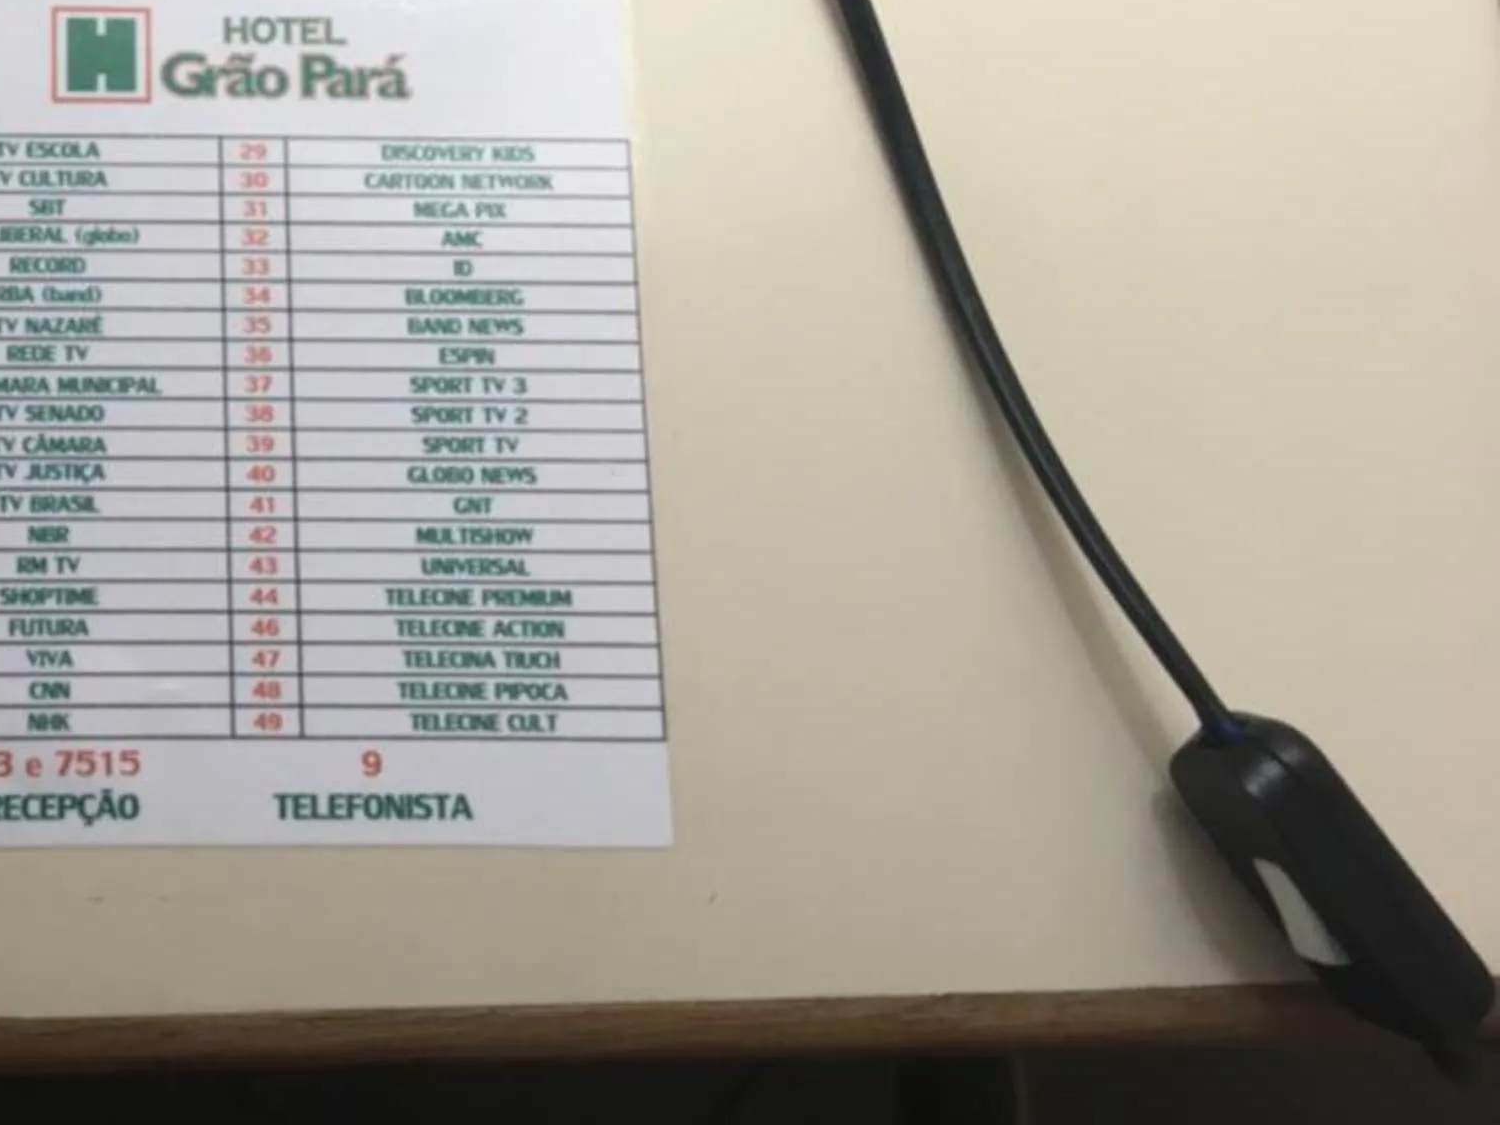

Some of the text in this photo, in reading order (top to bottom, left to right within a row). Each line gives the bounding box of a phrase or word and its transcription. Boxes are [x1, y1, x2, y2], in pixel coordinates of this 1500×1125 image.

[222, 17, 346, 45] HOTEL
[161, 51, 411, 100] Grão Pará
[25, 142, 100, 158] ESCOLA
[239, 145, 267, 159] 29
[381, 145, 534, 162] DISCOVERY KIDS
[19, 171, 108, 186] CULTURA
[240, 174, 268, 188] 30
[365, 174, 553, 190] CARTOON NETWORK
[29, 199, 66, 215] SBT
[243, 203, 267, 216] 31
[413, 202, 507, 219] MEGA PIX
[75, 227, 139, 247] (globo)
[241, 231, 269, 246] 32
[441, 231, 482, 247] AMC
[9, 257, 86, 273] RECORD
[242, 260, 270, 274] 33
[453, 261, 472, 276] ID
[42, 287, 102, 303] (band)
[243, 288, 270, 303] 34
[405, 288, 524, 306] BLOOMBERG
[25, 315, 103, 334] NAZARÉ
[243, 318, 270, 332] 35
[408, 318, 523, 335] BAND NEWS
[6, 346, 89, 362] REDE TV
[244, 347, 271, 363] 36
[57, 378, 161, 394] MUNICIPAL
[244, 377, 273, 392] 37
[410, 378, 527, 394] SPORT TV 3
[24, 406, 105, 421] SENADO
[245, 408, 274, 422] 38
[410, 408, 528, 424] SPORT TV 2
[23, 434, 106, 453] CÂMARA
[246, 437, 274, 452] 39
[422, 437, 520, 454] SPORT TV
[24, 464, 106, 483] JUSTIÇA
[247, 467, 276, 482] 40
[407, 467, 537, 484] GLOBO NEWS
[0, 495, 100, 513] TV BRASIL
[249, 498, 275, 513] 41
[453, 498, 492, 514] GNT
[27, 527, 69, 543] NBR
[249, 528, 276, 543] 42
[416, 528, 533, 545] MULTISHOW
[16, 557, 81, 573] RM TV
[249, 558, 277, 574] 43
[422, 559, 531, 576] UNIVERSAL
[0, 588, 99, 605] SHOPTIME
[249, 589, 278, 604] 44
[386, 589, 572, 606] TELECINE PREMIUM
[8, 620, 88, 636] FUTURA
[250, 620, 280, 636] 46
[396, 620, 565, 638] TELECINE ACTION
[27, 651, 74, 667] VIVA
[252, 651, 280, 667] 47
[29, 682, 70, 699] CNN
[253, 682, 281, 699] 48
[398, 682, 567, 700] TELECINE PIPOCA
[27, 714, 71, 731] NHK
[253, 714, 283, 730] 49
[410, 714, 558, 731] TELECINE CULT
[26, 756, 43, 777] e
[55, 749, 141, 777] 7515
[362, 750, 382, 776] 9
[273, 793, 473, 820] TELEFONISTA
